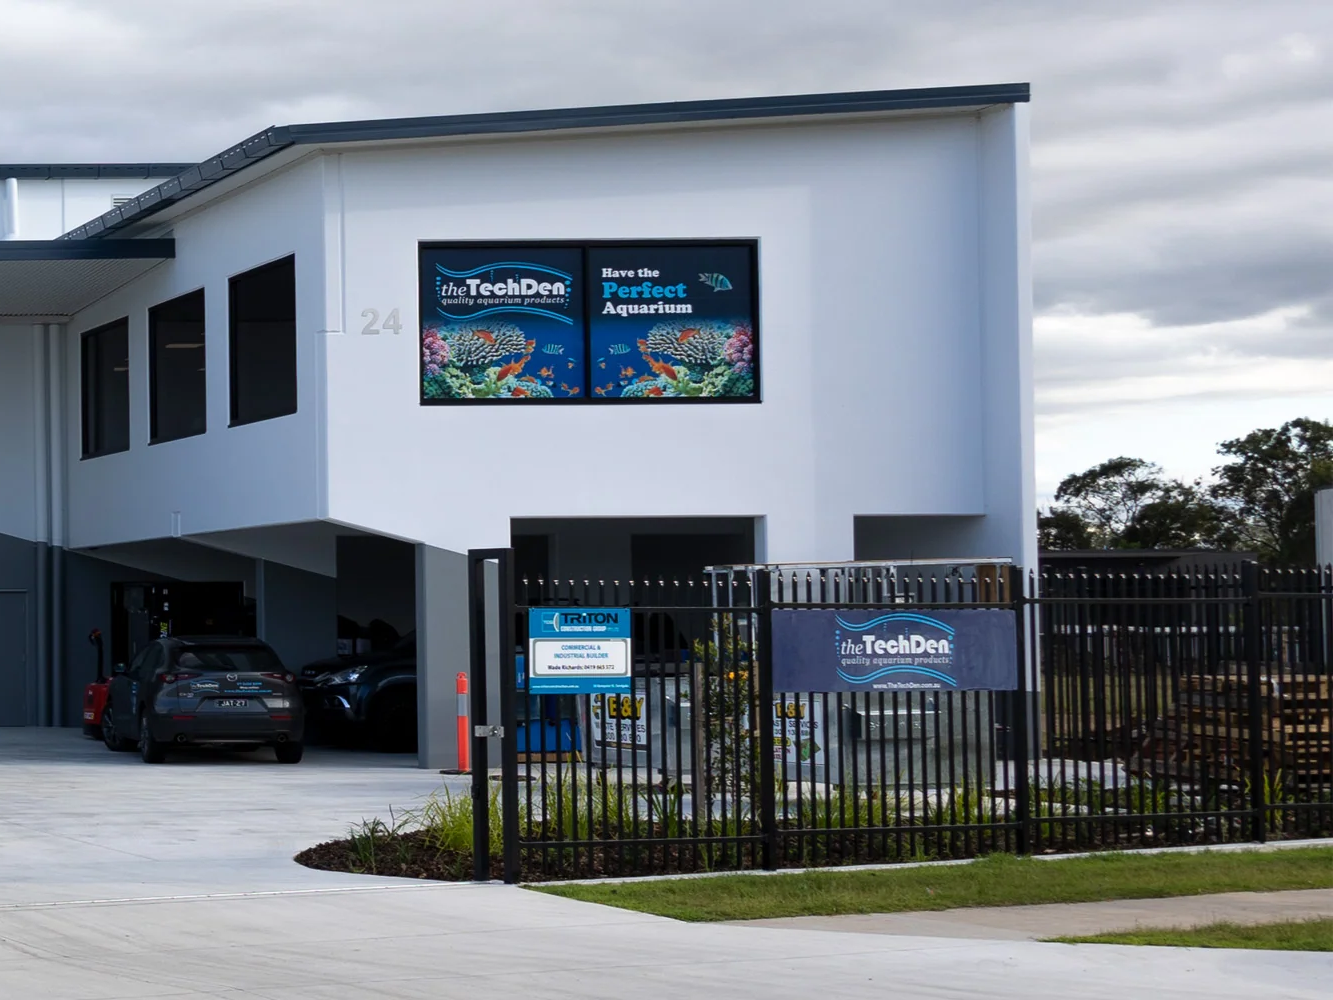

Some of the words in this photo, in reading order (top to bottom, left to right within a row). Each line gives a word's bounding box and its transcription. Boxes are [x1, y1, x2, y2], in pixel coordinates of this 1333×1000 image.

[601, 268, 635, 278] Have
[637, 268, 660, 278] the
[602, 281, 687, 298] Perfect
[441, 296, 475, 306] quality
[477, 296, 522, 306] aquarium
[524, 296, 565, 306] products
[602, 301, 693, 317] Aquarium
[360, 308, 403, 335] 24
[841, 656, 870, 666] quality
[873, 656, 913, 666] aquarium
[914, 656, 949, 666] products
